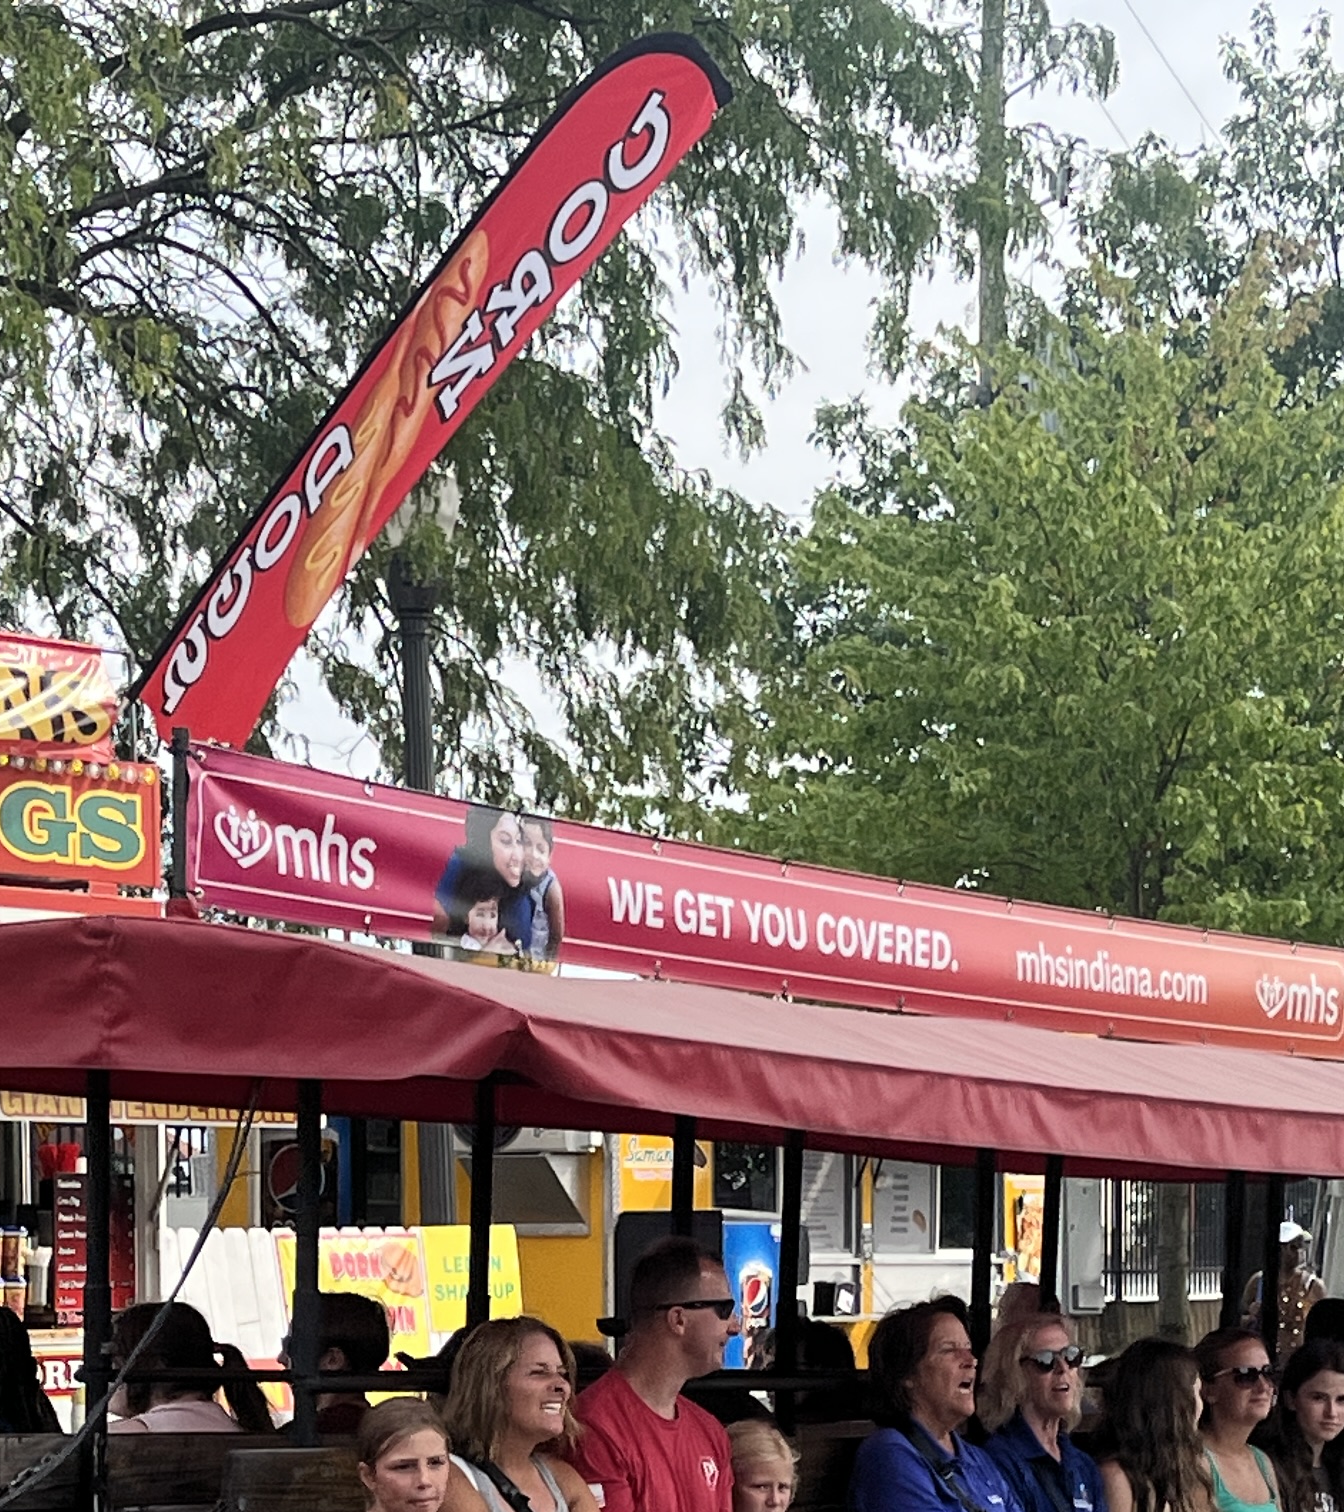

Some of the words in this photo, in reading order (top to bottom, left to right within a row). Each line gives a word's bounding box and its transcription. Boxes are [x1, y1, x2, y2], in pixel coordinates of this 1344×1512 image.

[274, 812, 380, 892] mhs
[607, 874, 665, 931] WE
[672, 886, 735, 942] GET
[741, 898, 809, 953] YOU
[814, 908, 960, 974] COVERED.
[1015, 940, 1209, 1006] mhsindiana.com
[1287, 982, 1339, 1028] mhs
